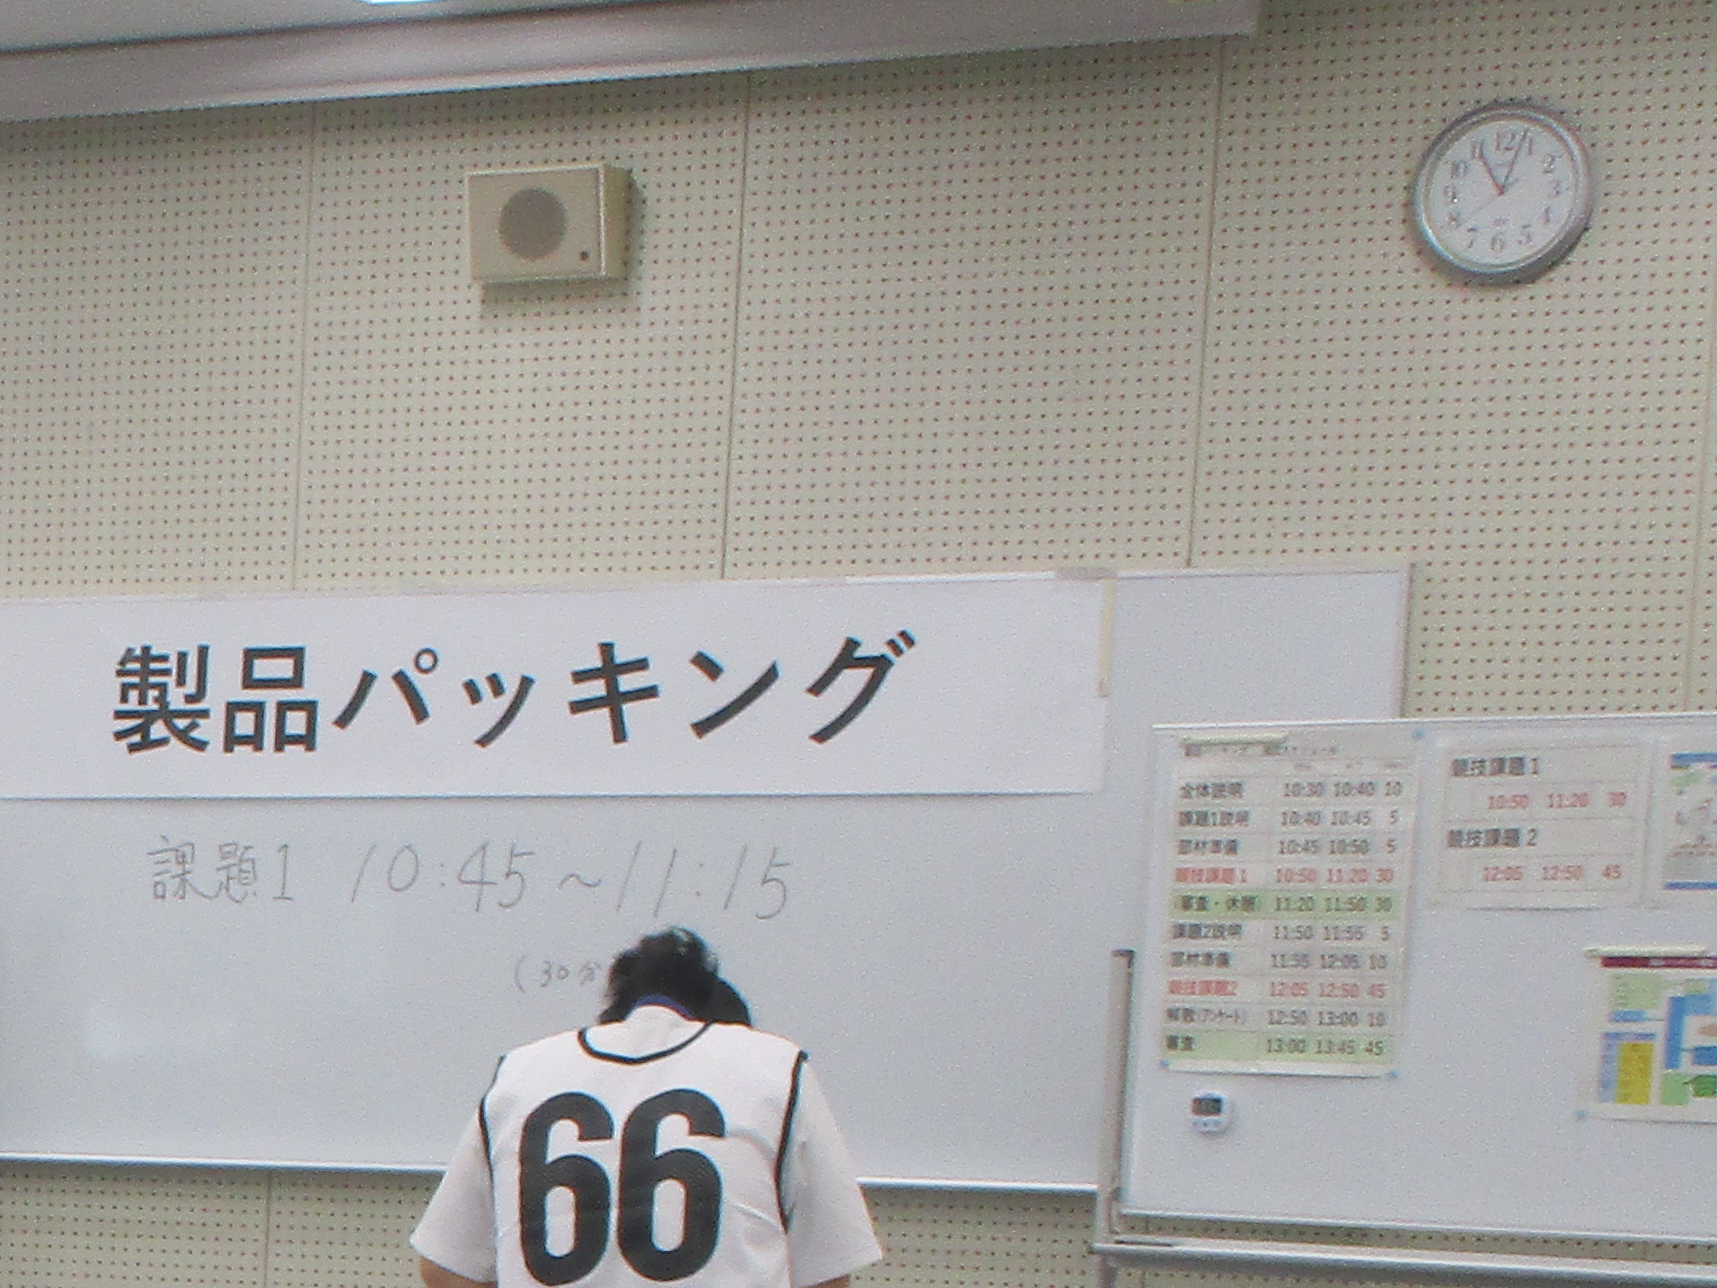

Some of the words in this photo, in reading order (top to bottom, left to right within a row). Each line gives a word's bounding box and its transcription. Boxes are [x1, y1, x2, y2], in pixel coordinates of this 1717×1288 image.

[112, 629, 916, 755] 製品パッキング
[1284, 781, 1325, 798] 10:30
[1334, 780, 1376, 798] 10:40
[1384, 780, 1403, 797] 10
[1330, 810, 1372, 827] 10:45
[1278, 838, 1319, 856] 10:45
[1276, 867, 1318, 884] 10:50
[1326, 867, 1370, 884] 11:20
[1376, 867, 1395, 884] 30
[1275, 895, 1315, 913] 11:20
[1274, 924, 1314, 941] 11:50
[1268, 1008, 1308, 1026] 12:50
[1267, 1036, 1307, 1054] 13:00
[1365, 1038, 1384, 1056] 45
[518, 1088, 726, 1287] 66
